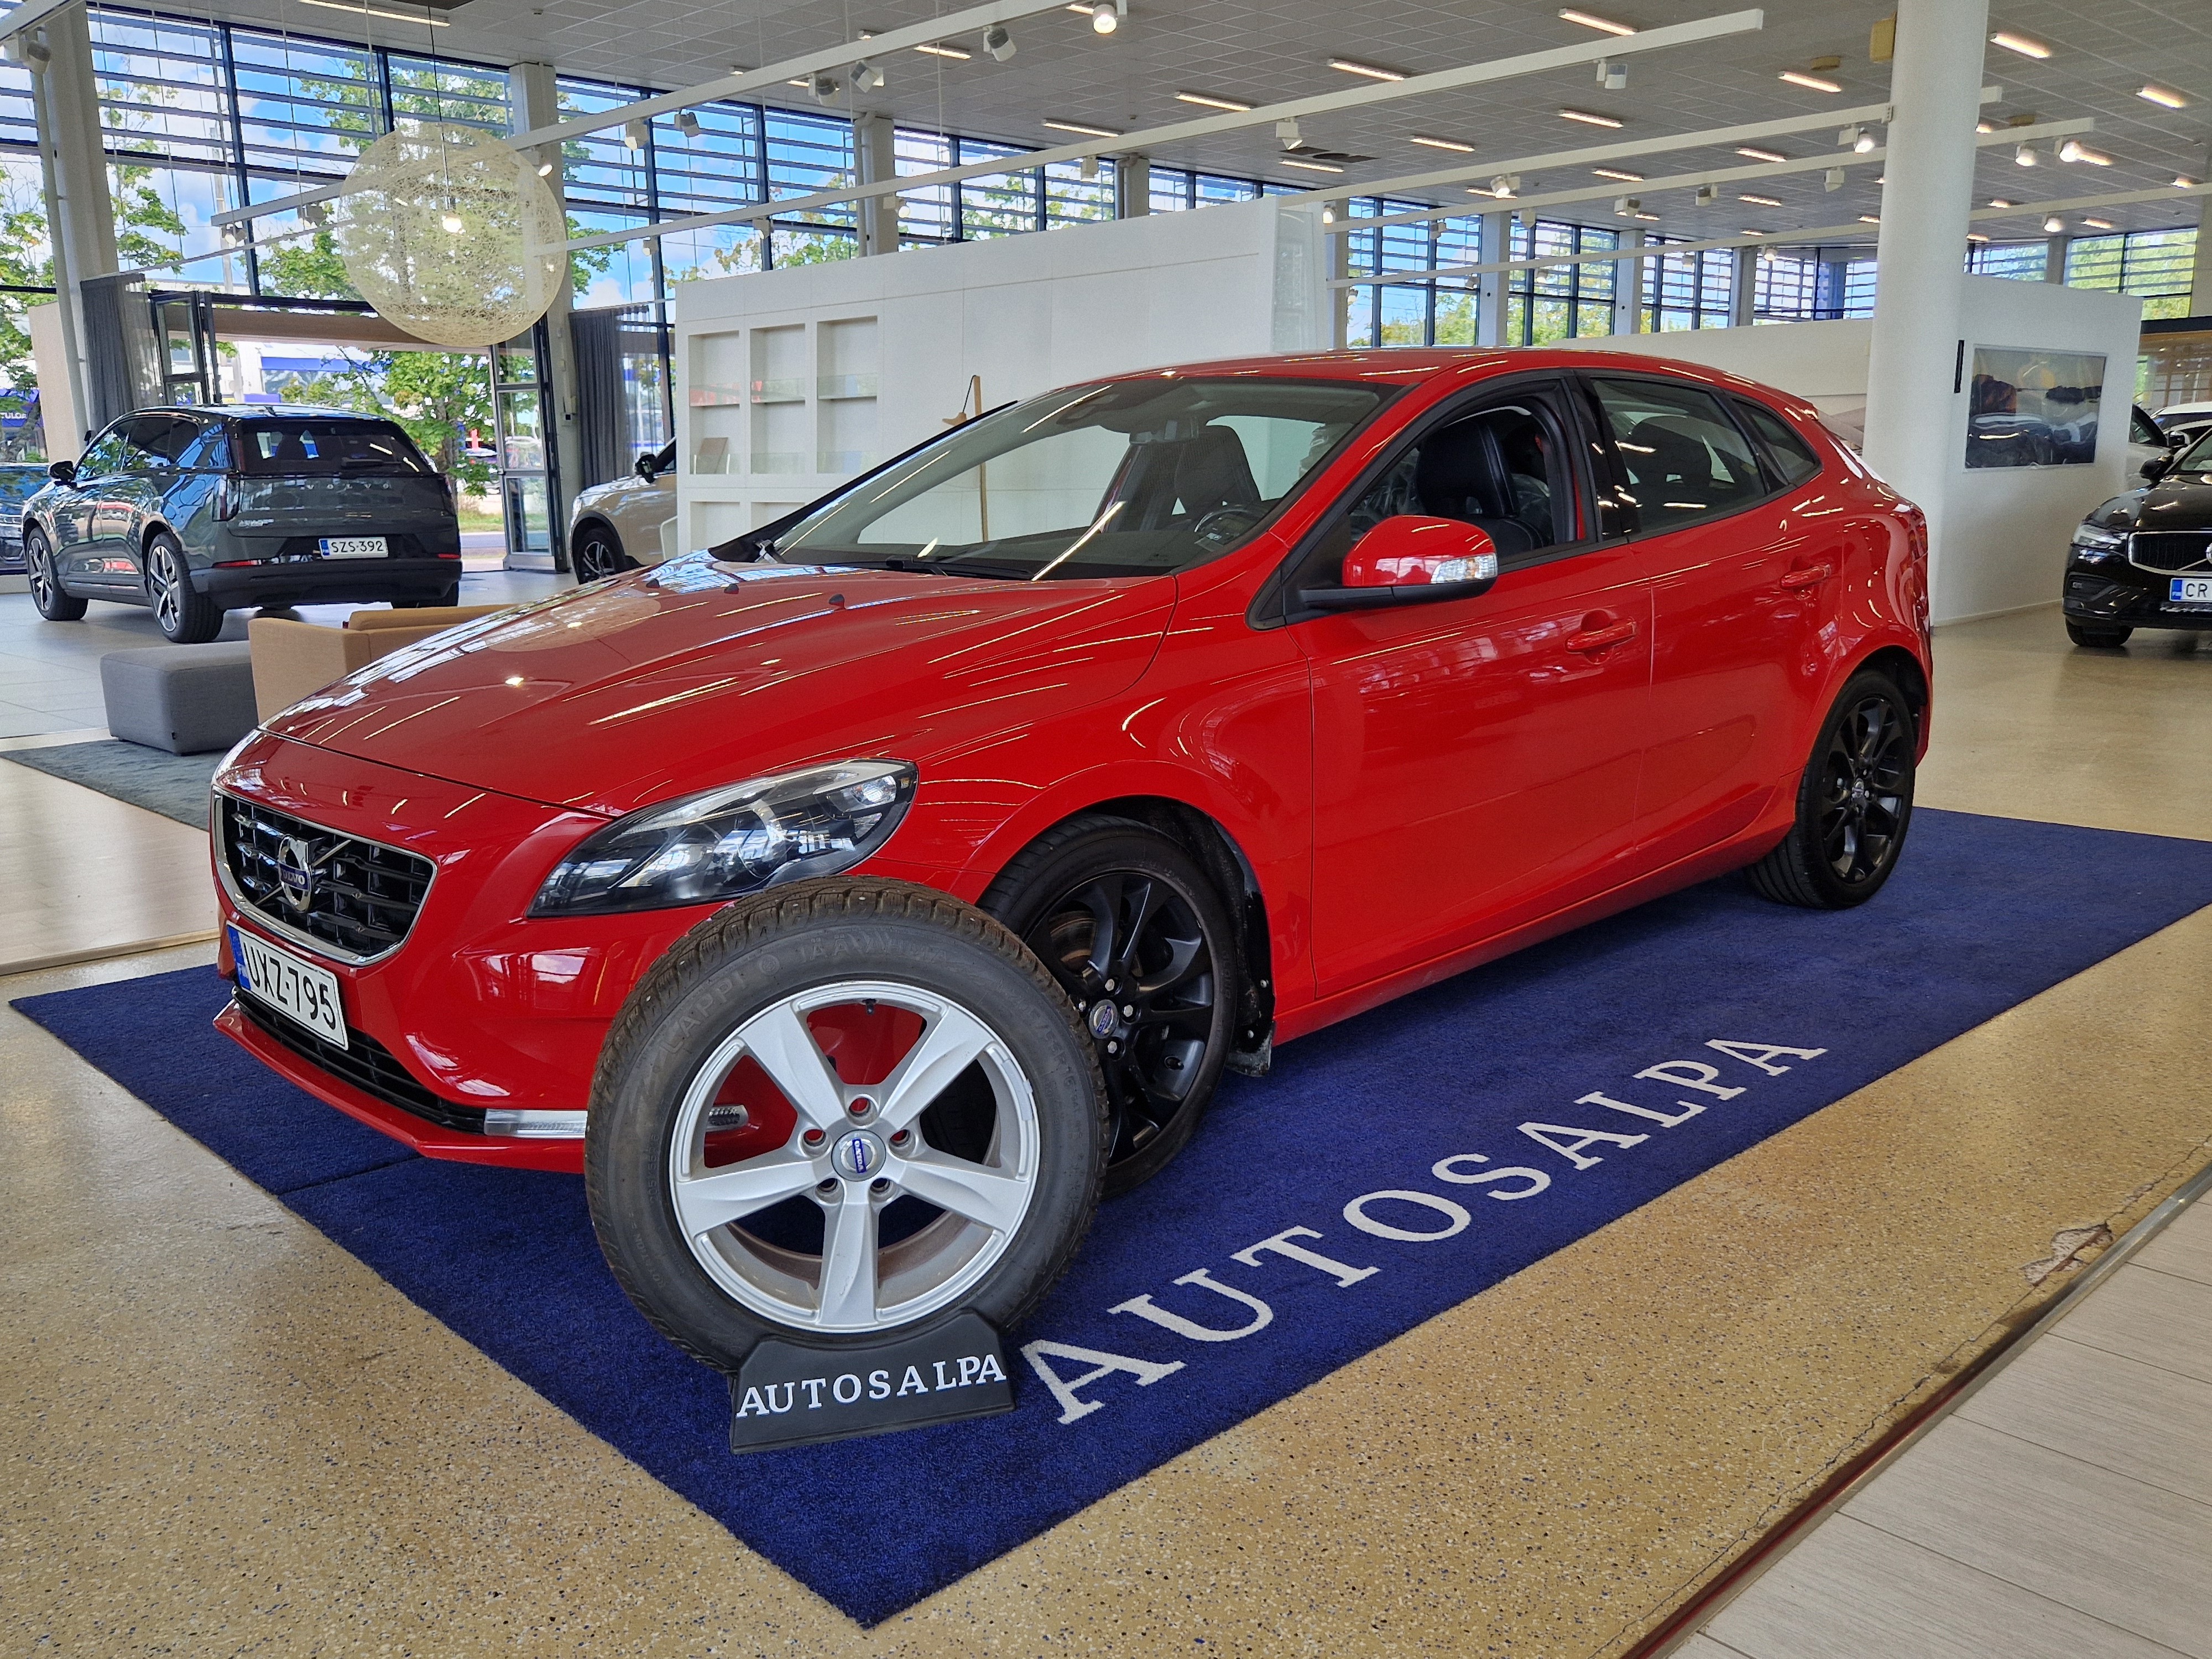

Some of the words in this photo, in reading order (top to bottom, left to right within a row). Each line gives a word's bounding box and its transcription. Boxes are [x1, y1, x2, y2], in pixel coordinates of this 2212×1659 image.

[331, 540, 384, 553] SZS-392
[244, 942, 336, 1030] UXZ-795
[660, 972, 749, 1054] LAPPI
[1021, 1038, 1827, 1425] AUTOSALPA
[736, 1353, 1006, 1418] AUTOSALPA
